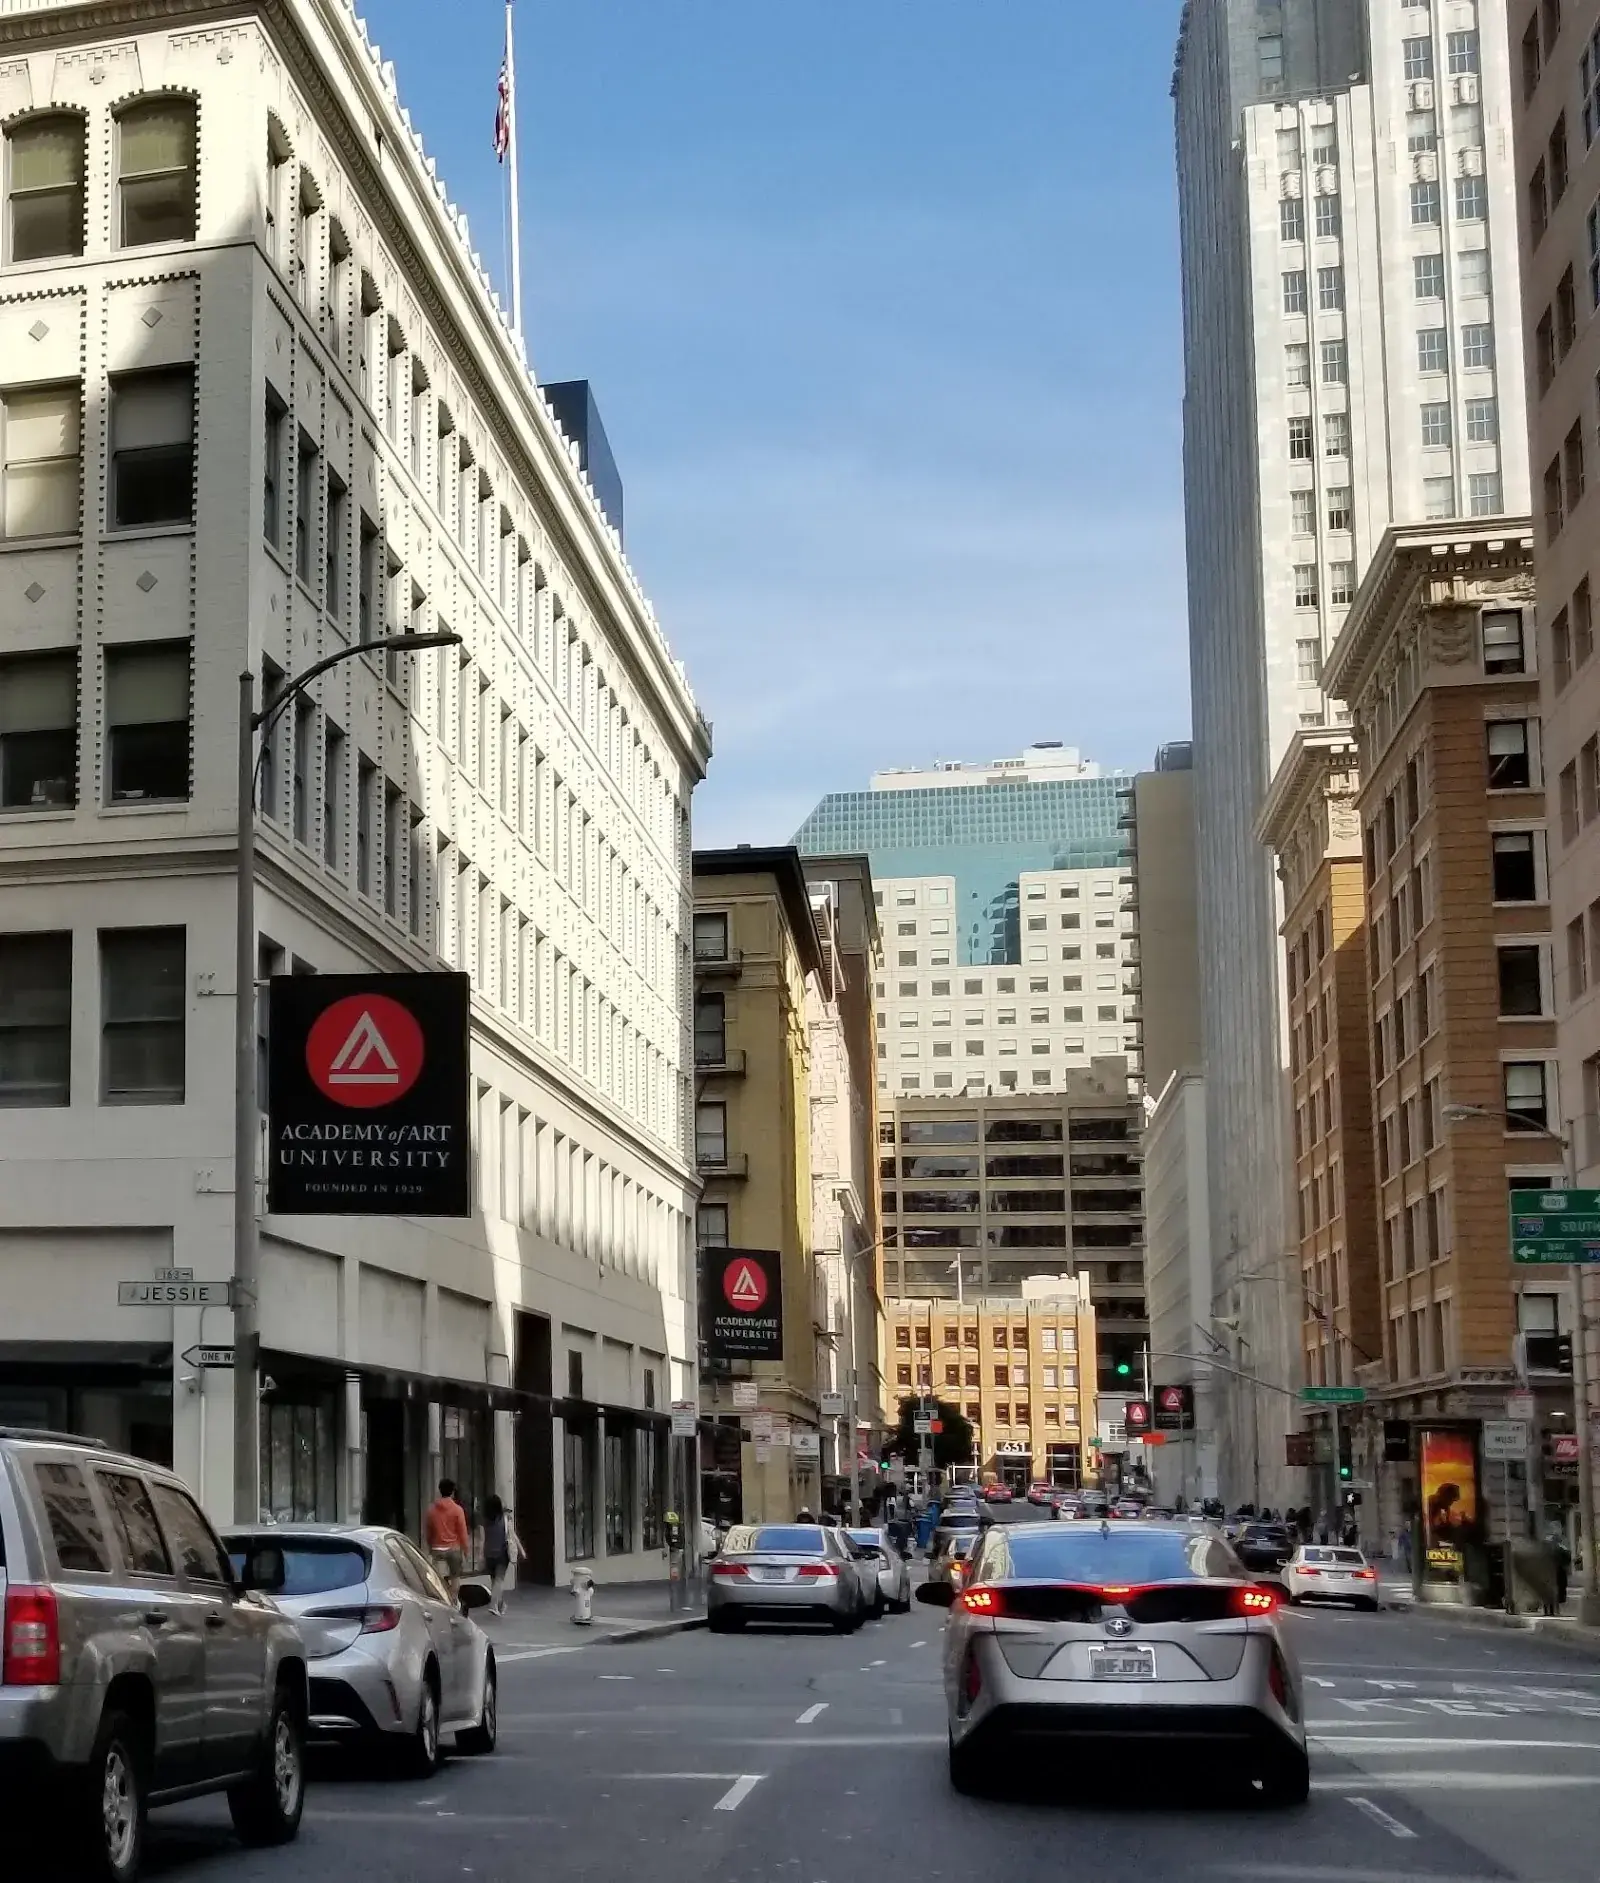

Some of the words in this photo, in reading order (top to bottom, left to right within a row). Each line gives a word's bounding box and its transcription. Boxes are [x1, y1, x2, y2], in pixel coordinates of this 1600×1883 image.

[281, 1124, 388, 1141] ACADEMY
[388, 1127, 408, 1145] of
[407, 1125, 451, 1141] ART
[280, 1150, 449, 1168] UNIVERSITY
[305, 1183, 367, 1193] FOUNDED
[374, 1184, 388, 1193] IN
[394, 1184, 423, 1194] 1929
[140, 1287, 209, 1301] JESSIE
[715, 1317, 756, 1326] ACADEMY
[763, 1319, 778, 1328] ART
[715, 1329, 777, 1340] UNIVERSITY
[201, 1352, 219, 1361] ONE
[223, 1352, 235, 1361] WA
[1495, 1436, 1518, 1444] MUST
[1003, 1441, 1026, 1452] 631
